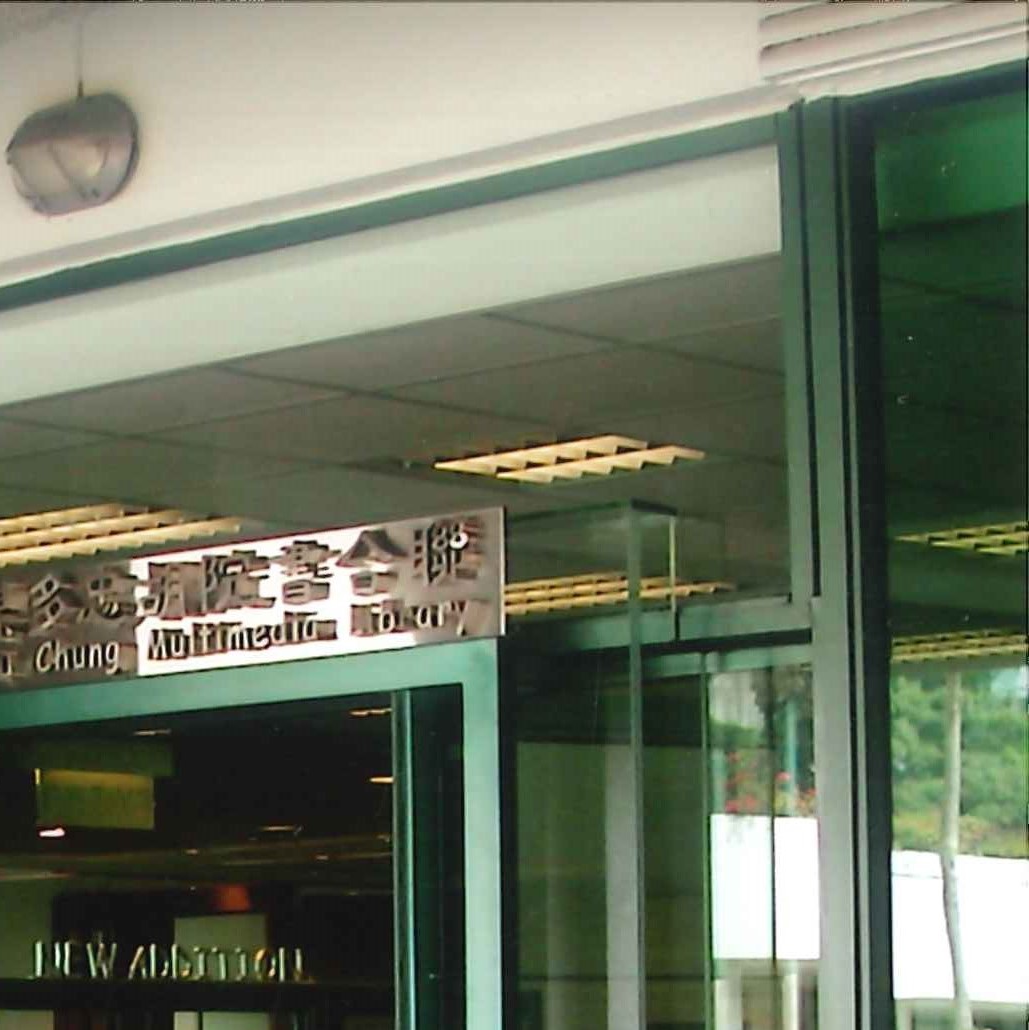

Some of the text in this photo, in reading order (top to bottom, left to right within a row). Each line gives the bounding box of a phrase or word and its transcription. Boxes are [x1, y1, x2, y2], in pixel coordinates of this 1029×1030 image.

[35, 639, 120, 675] Chung
[148, 612, 318, 660] Multimedia
[34, 940, 117, 978] NEW
